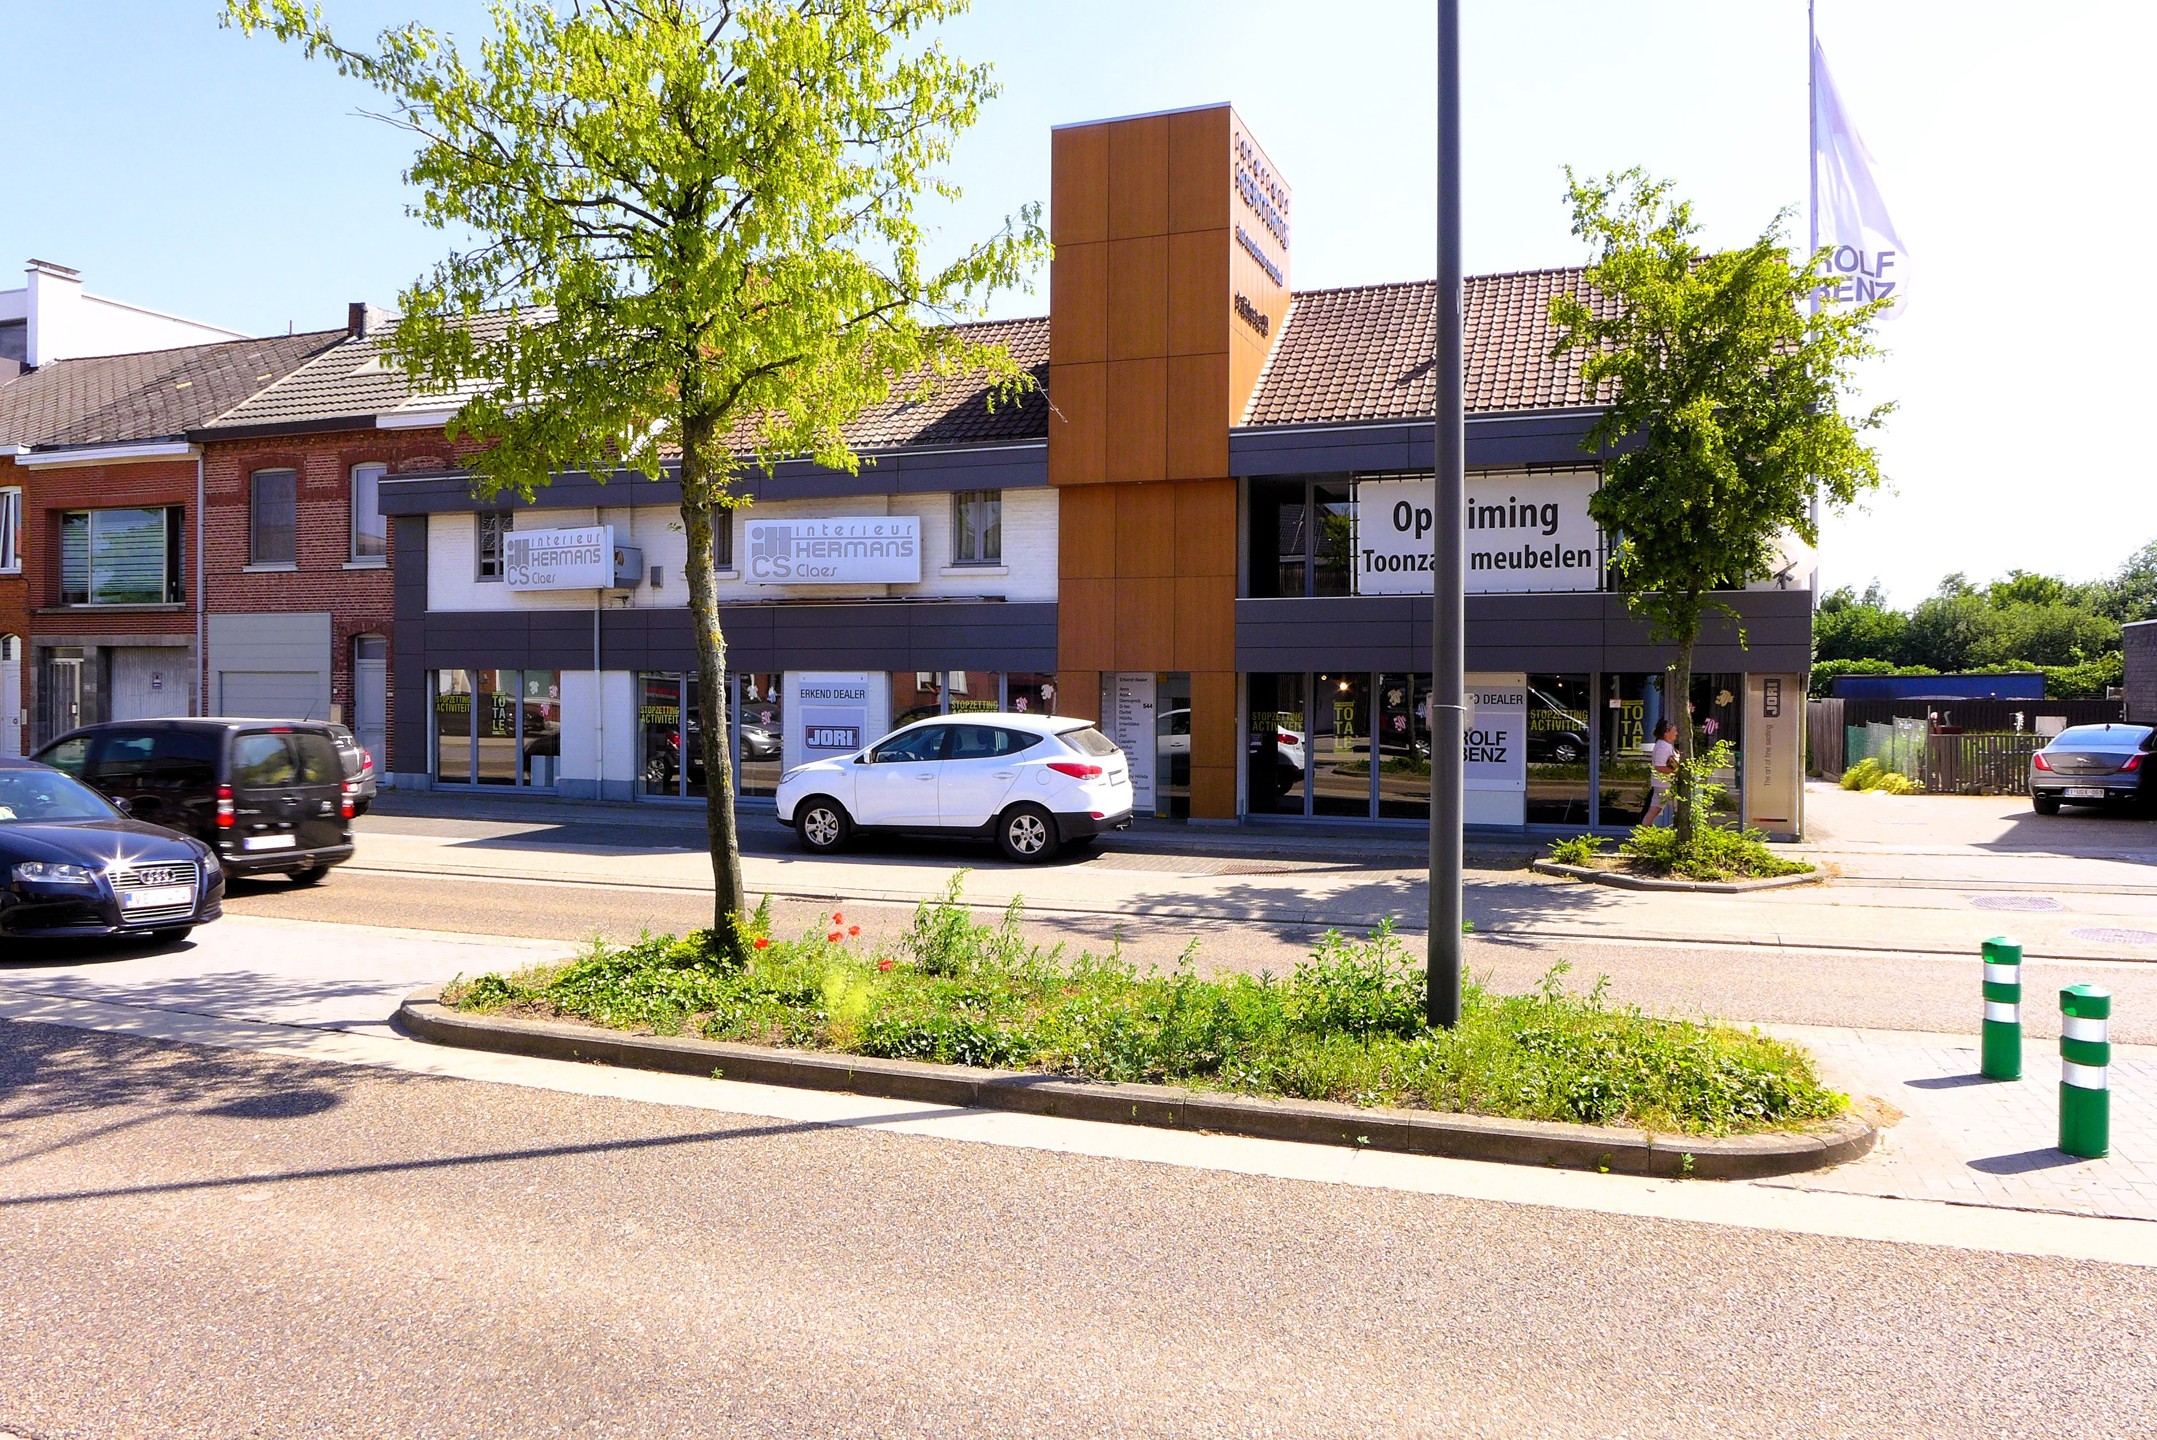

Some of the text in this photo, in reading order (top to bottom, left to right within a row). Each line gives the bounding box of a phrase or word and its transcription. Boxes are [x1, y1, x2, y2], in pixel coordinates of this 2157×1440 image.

[1393, 496, 1559, 540] Opiming
[796, 523, 912, 537] interieur
[531, 533, 601, 548] interieur
[795, 540, 914, 558] HERMANS
[531, 547, 601, 567] HERMANS
[1471, 543, 1592, 570] meubelen
[751, 555, 792, 578] CS
[796, 563, 838, 578] Claes
[507, 565, 530, 585] CS
[531, 571, 557, 585] Claes
[435, 694, 471, 704] STOPZETTING
[800, 689, 866, 699] ERKEND DEALER
[1483, 694, 1523, 705] DEALER
[1766, 681, 1778, 716] JORI
[435, 703, 471, 713] ACTIVITEIT
[640, 704, 680, 715] STOPZETTING
[951, 699, 999, 710] STOPZETTING
[640, 714, 679, 725] ACTIVITEIT
[1251, 711, 1304, 721] STOPZETTING
[1530, 709, 1589, 720] STOPZETTING
[1252, 721, 1304, 732] ACTIVITEIT
[1530, 719, 1589, 732] ACTIVITEIT
[807, 729, 854, 747] JORI
